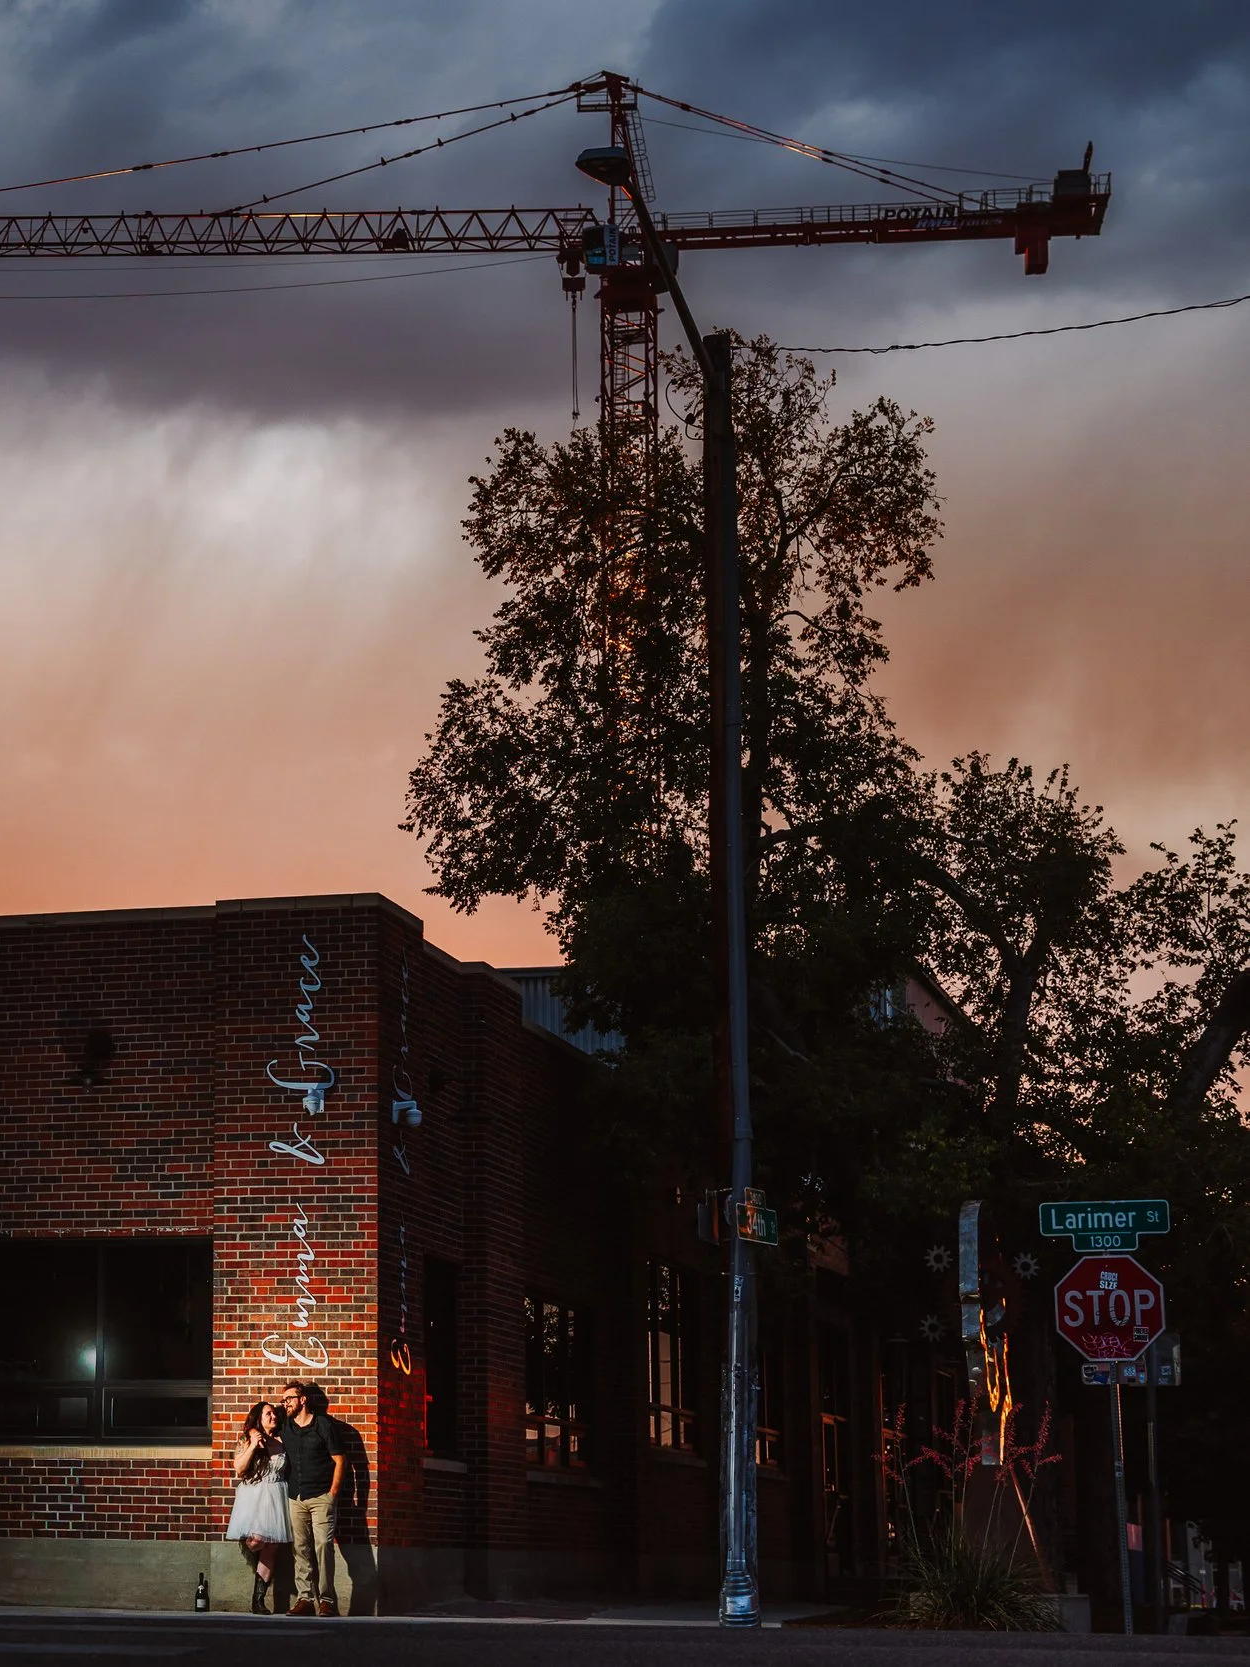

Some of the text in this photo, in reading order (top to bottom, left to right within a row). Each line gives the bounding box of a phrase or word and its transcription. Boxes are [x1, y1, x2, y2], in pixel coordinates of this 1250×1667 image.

[884, 207, 955, 219] POTAIN
[608, 228, 616, 262] POTAIN
[262, 934, 336, 1368] Emma & Grace
[747, 1210, 766, 1237] 34th
[1051, 1207, 1160, 1230] Larimer St
[1090, 1235, 1121, 1248] 1300
[1063, 1288, 1155, 1327] STOP
